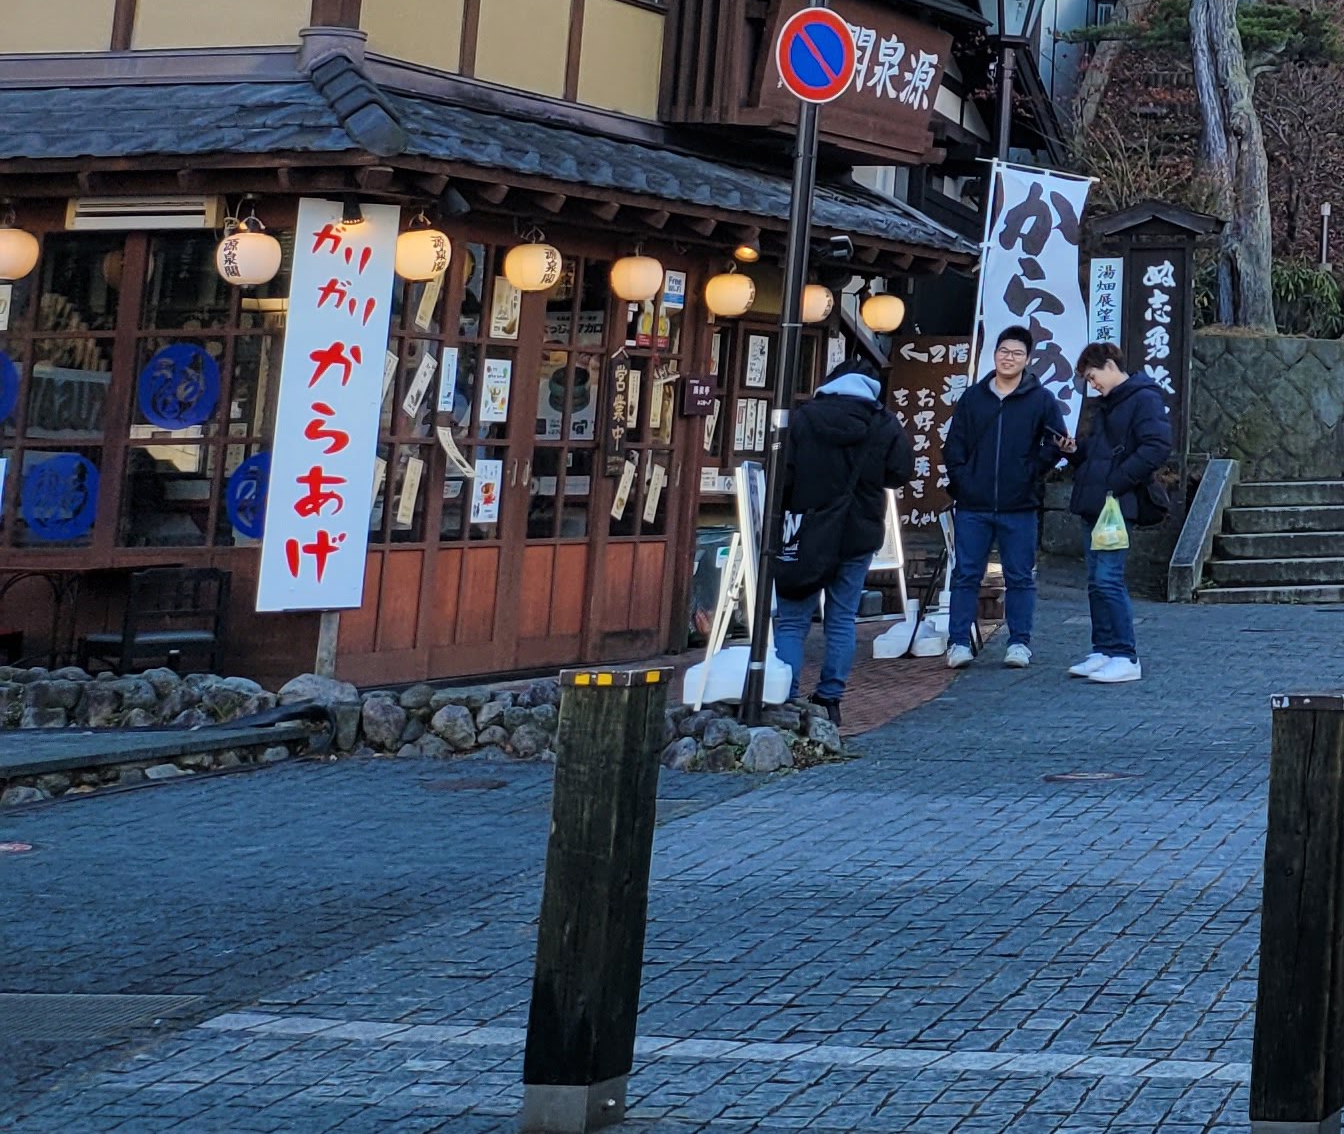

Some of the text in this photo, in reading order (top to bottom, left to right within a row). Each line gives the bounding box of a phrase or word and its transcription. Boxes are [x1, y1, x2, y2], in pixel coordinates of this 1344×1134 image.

[928, 342, 970, 364] 2階
[611, 363, 628, 451] 営業中
[909, 387, 936, 499] お好み焼き
